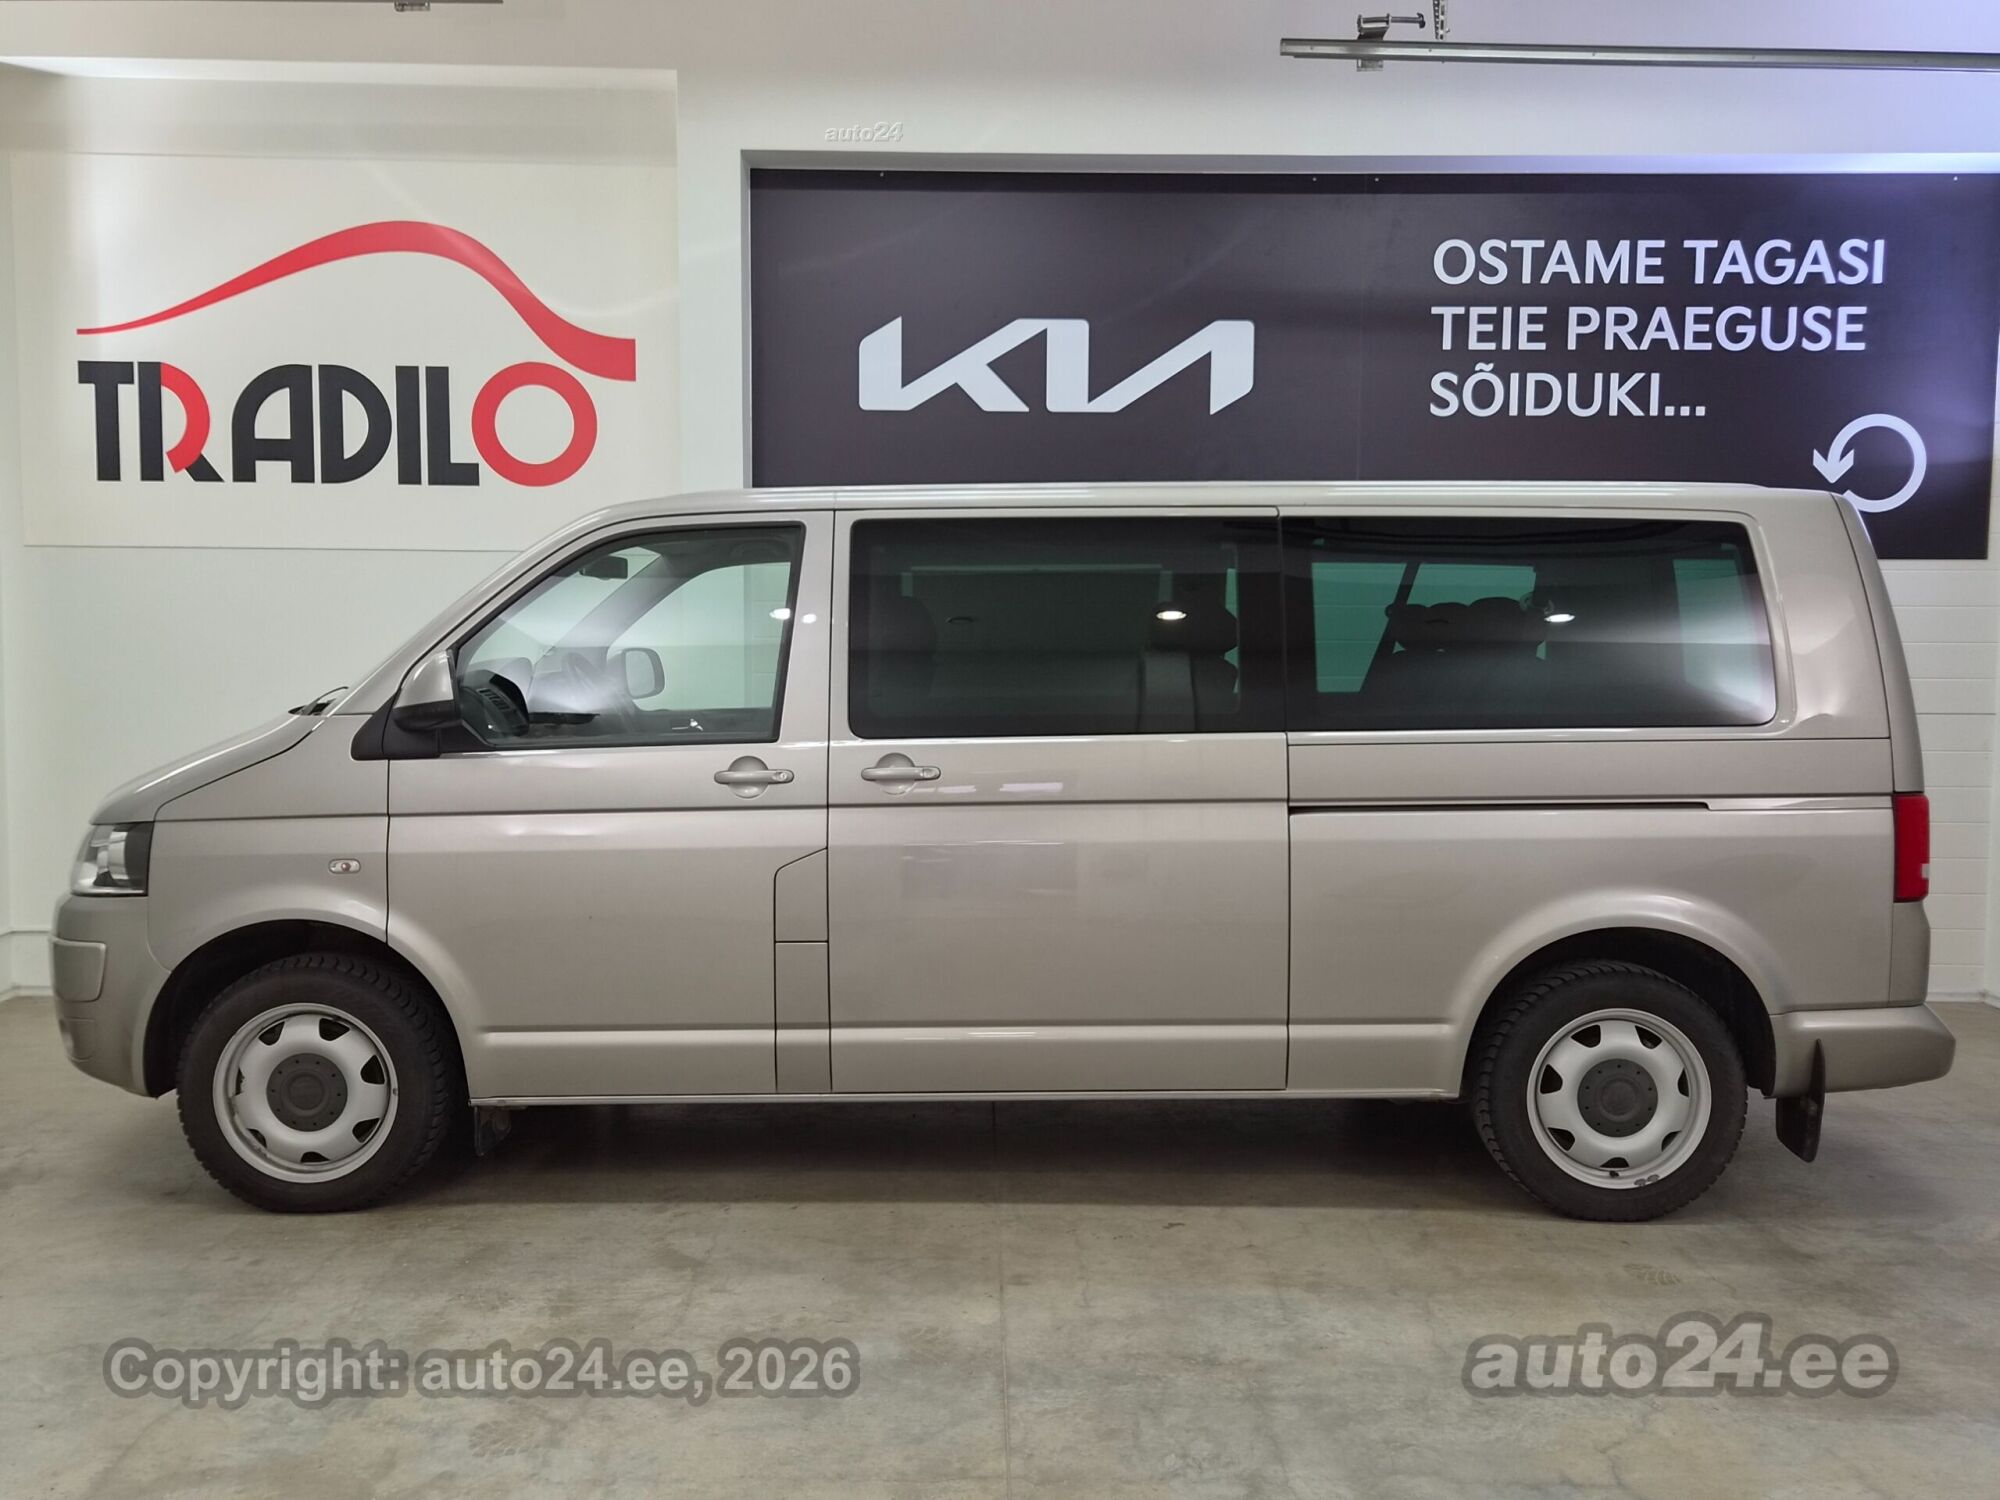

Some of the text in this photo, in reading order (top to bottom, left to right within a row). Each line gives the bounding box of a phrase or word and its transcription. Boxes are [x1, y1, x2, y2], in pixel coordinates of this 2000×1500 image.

[1434, 239, 1885, 284] OSTAME TAGASI
[1431, 305, 1868, 352] TEIE PRAEGUSE
[1430, 363, 1706, 418] SÕIDUKI...
[78, 361, 598, 486] TRADILO
